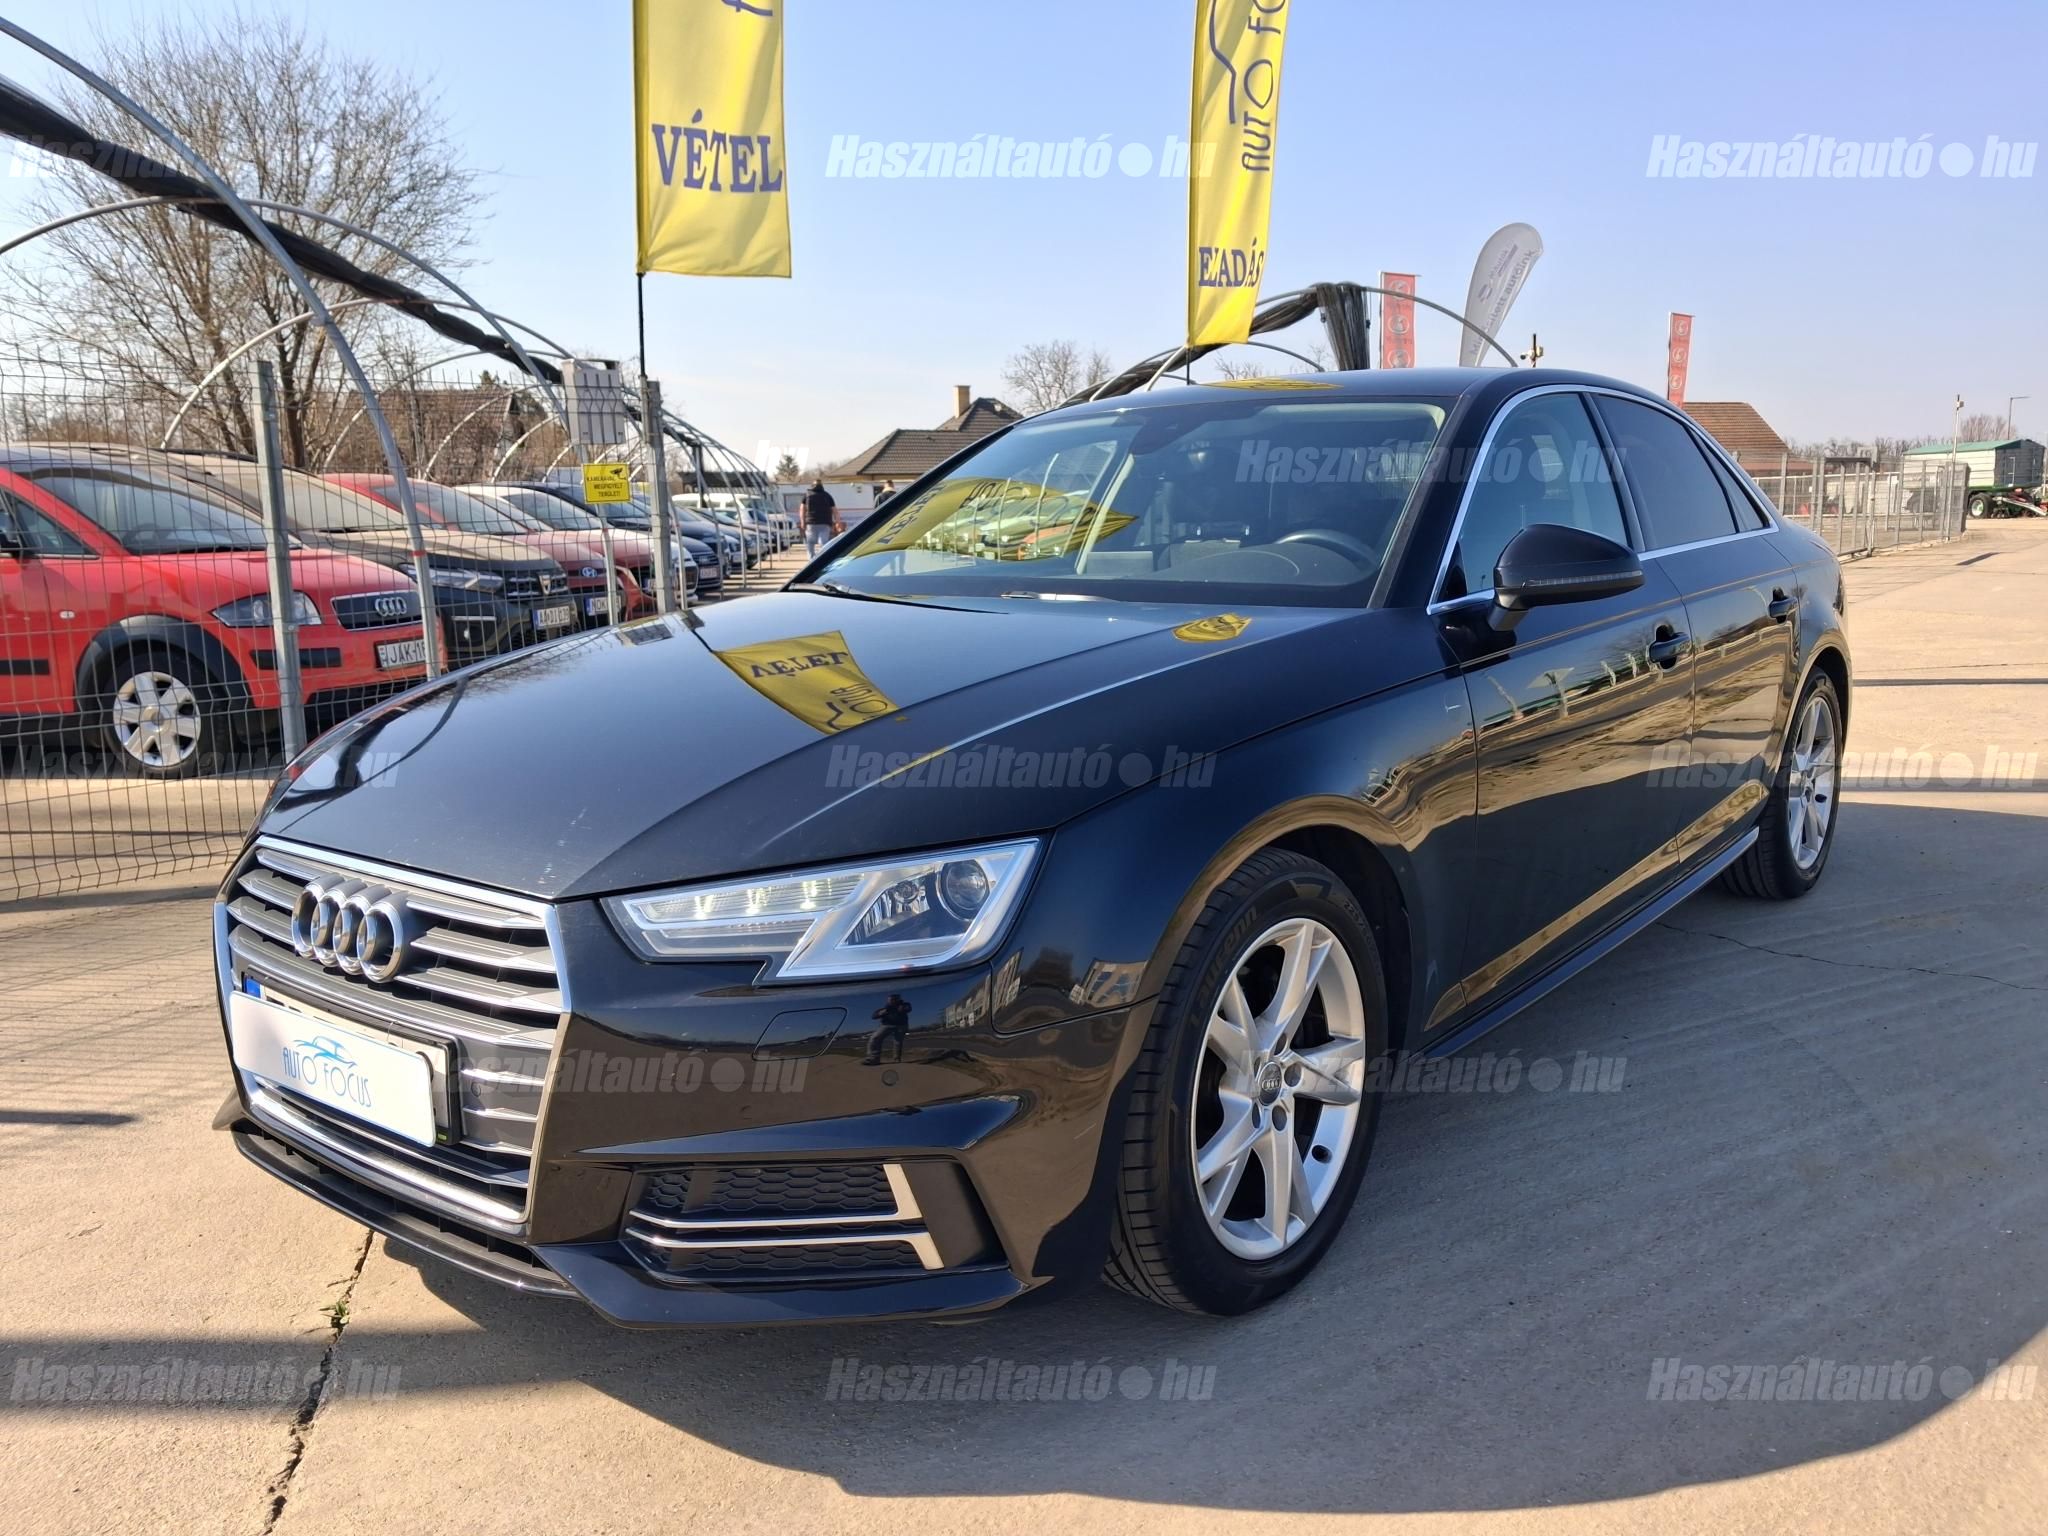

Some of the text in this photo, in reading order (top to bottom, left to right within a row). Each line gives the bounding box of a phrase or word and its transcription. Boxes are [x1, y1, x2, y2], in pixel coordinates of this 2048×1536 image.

[651, 108, 783, 194] VÉTEL
[1241, 59, 1273, 172] AUTO
[282, 1046, 372, 1108] AUTO FOCUS
